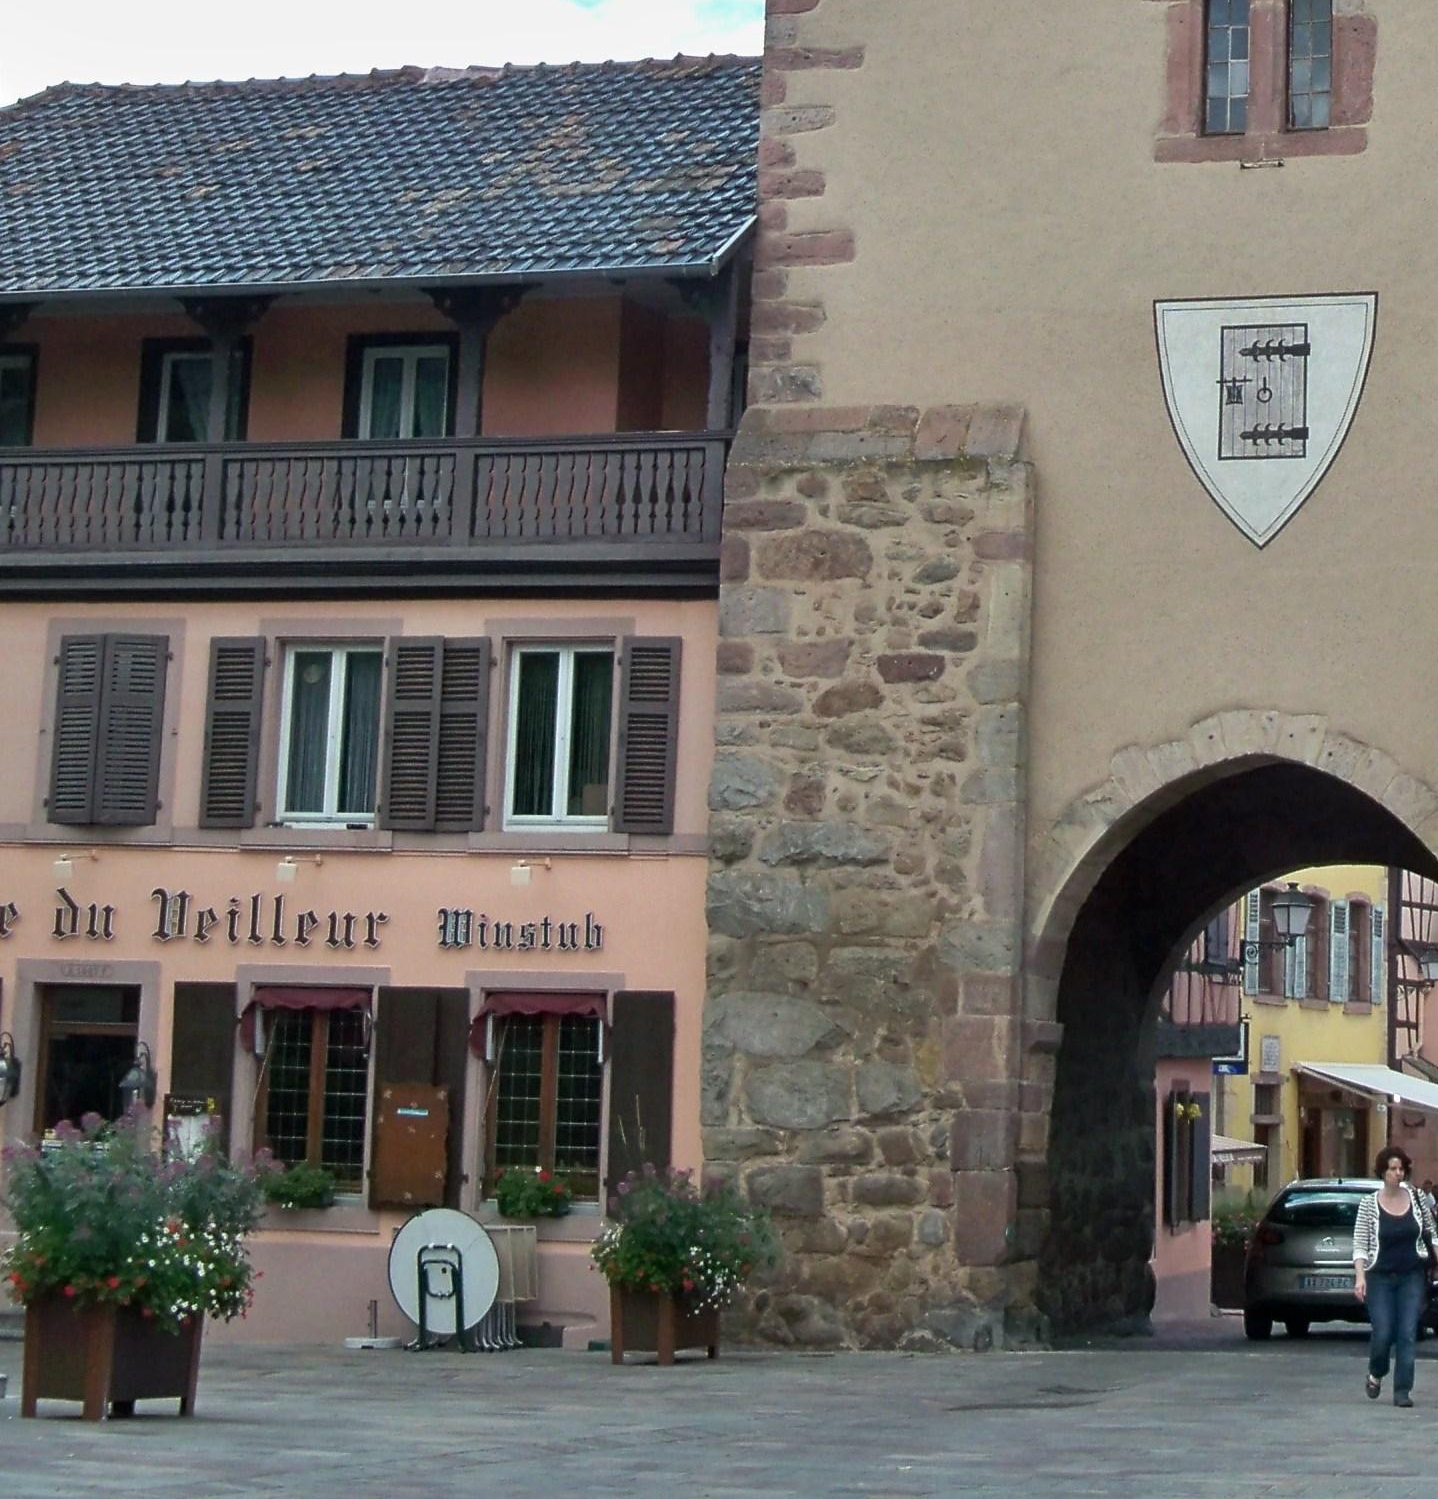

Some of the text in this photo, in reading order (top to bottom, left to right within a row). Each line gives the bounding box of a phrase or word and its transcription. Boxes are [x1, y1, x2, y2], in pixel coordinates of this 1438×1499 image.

[51, 887, 117, 941] du
[150, 886, 391, 949] Veilleur
[436, 907, 605, 951] Winstub
